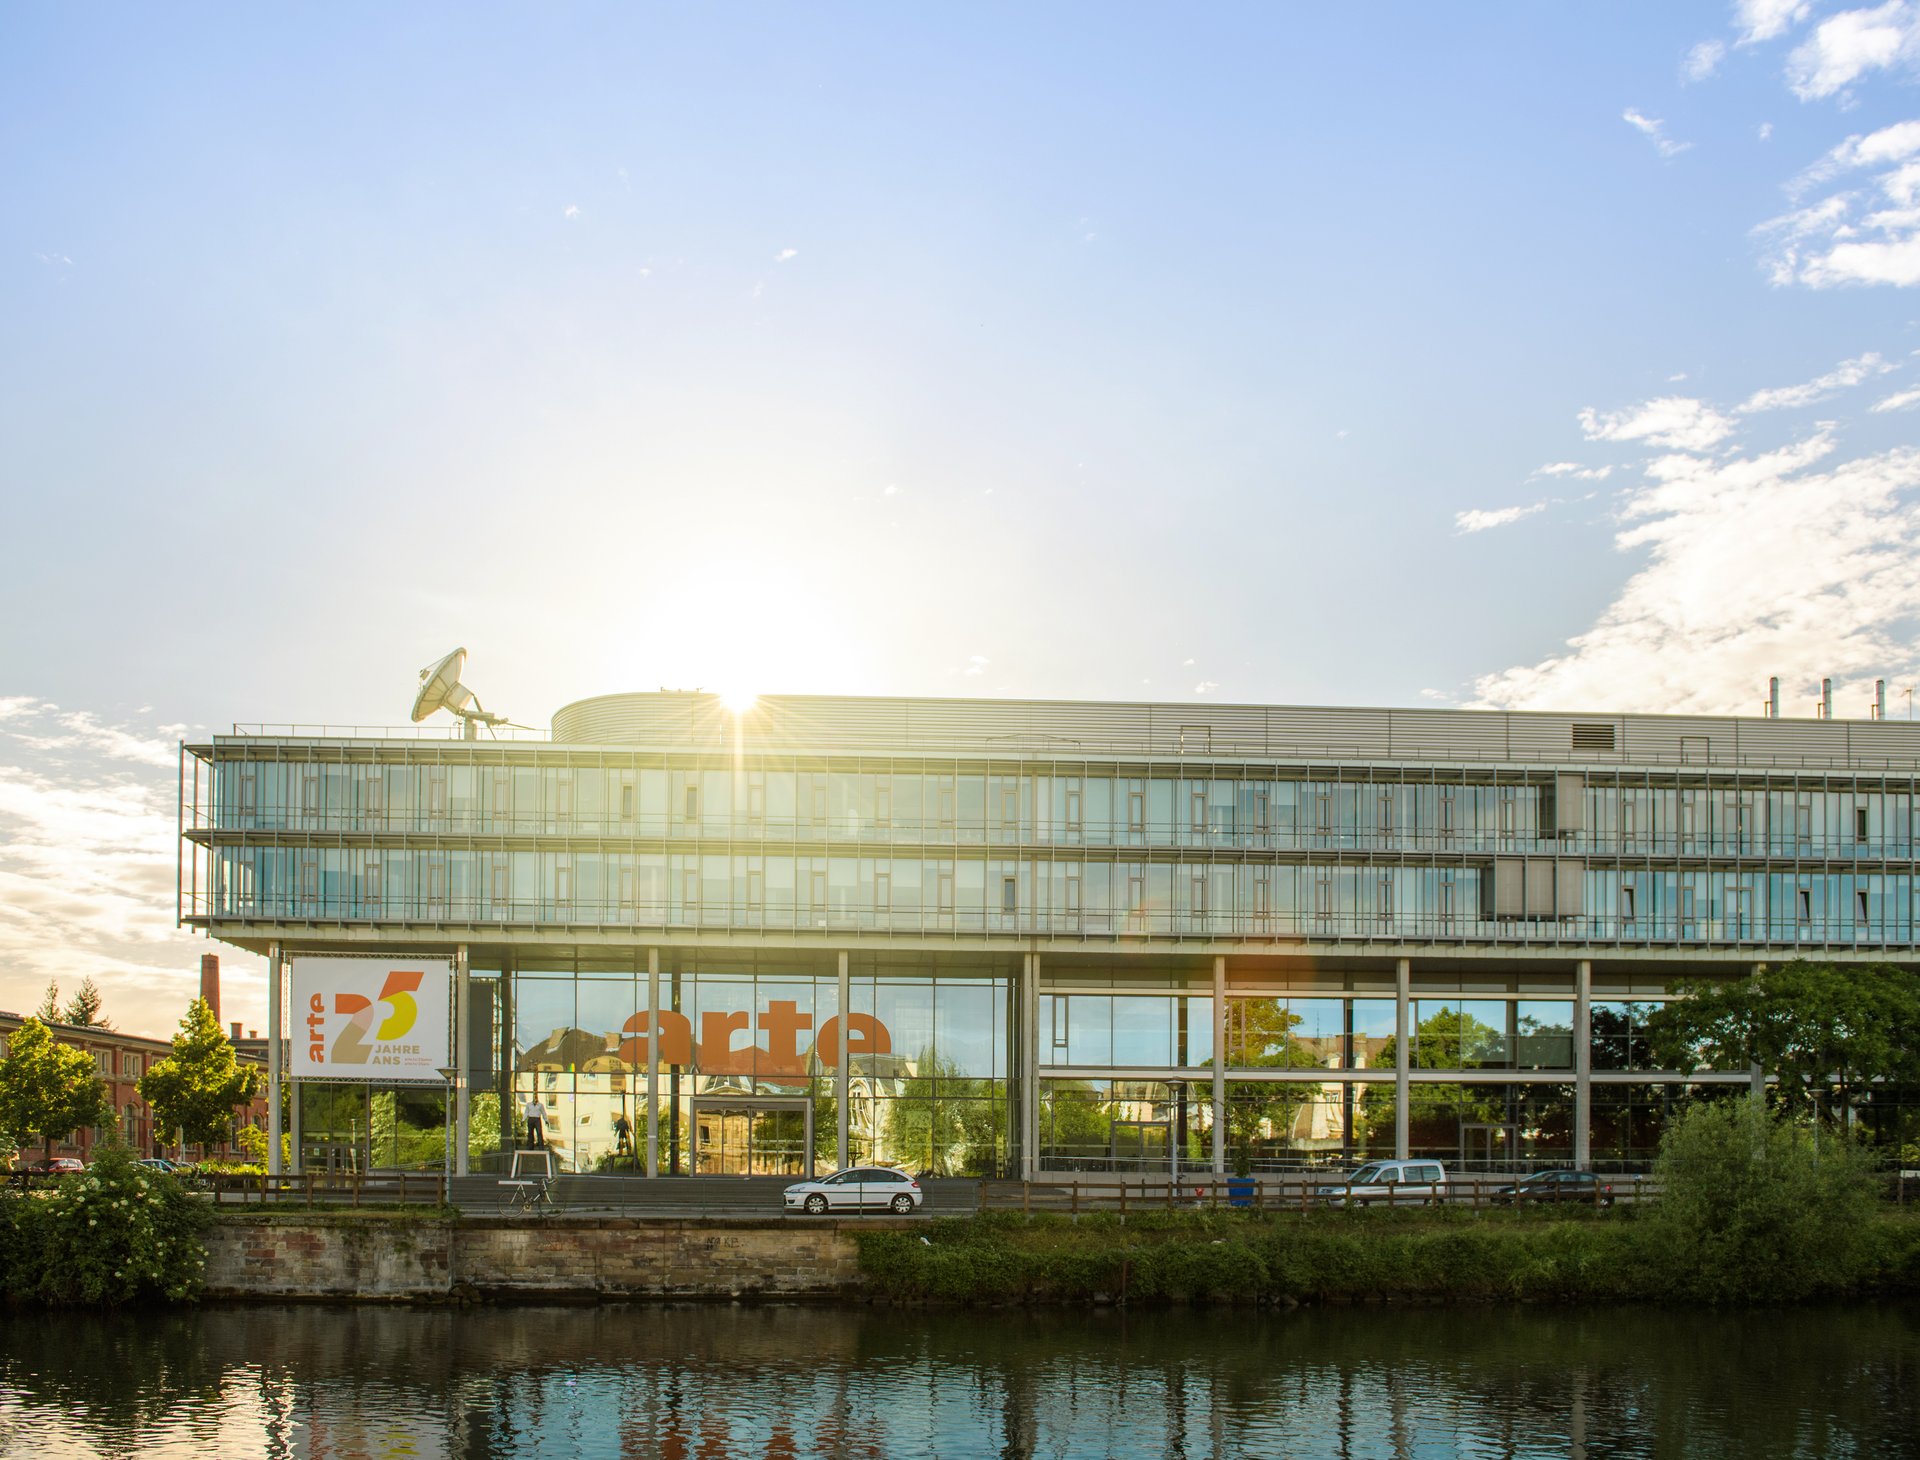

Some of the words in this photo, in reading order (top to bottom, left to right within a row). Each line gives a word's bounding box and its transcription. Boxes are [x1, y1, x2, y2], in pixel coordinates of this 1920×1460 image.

[307, 993, 324, 1063] arte
[331, 971, 424, 1064] 25
[375, 1045, 420, 1054] JAHRE
[619, 1000, 892, 1066] arte
[372, 1056, 400, 1065] ANS
